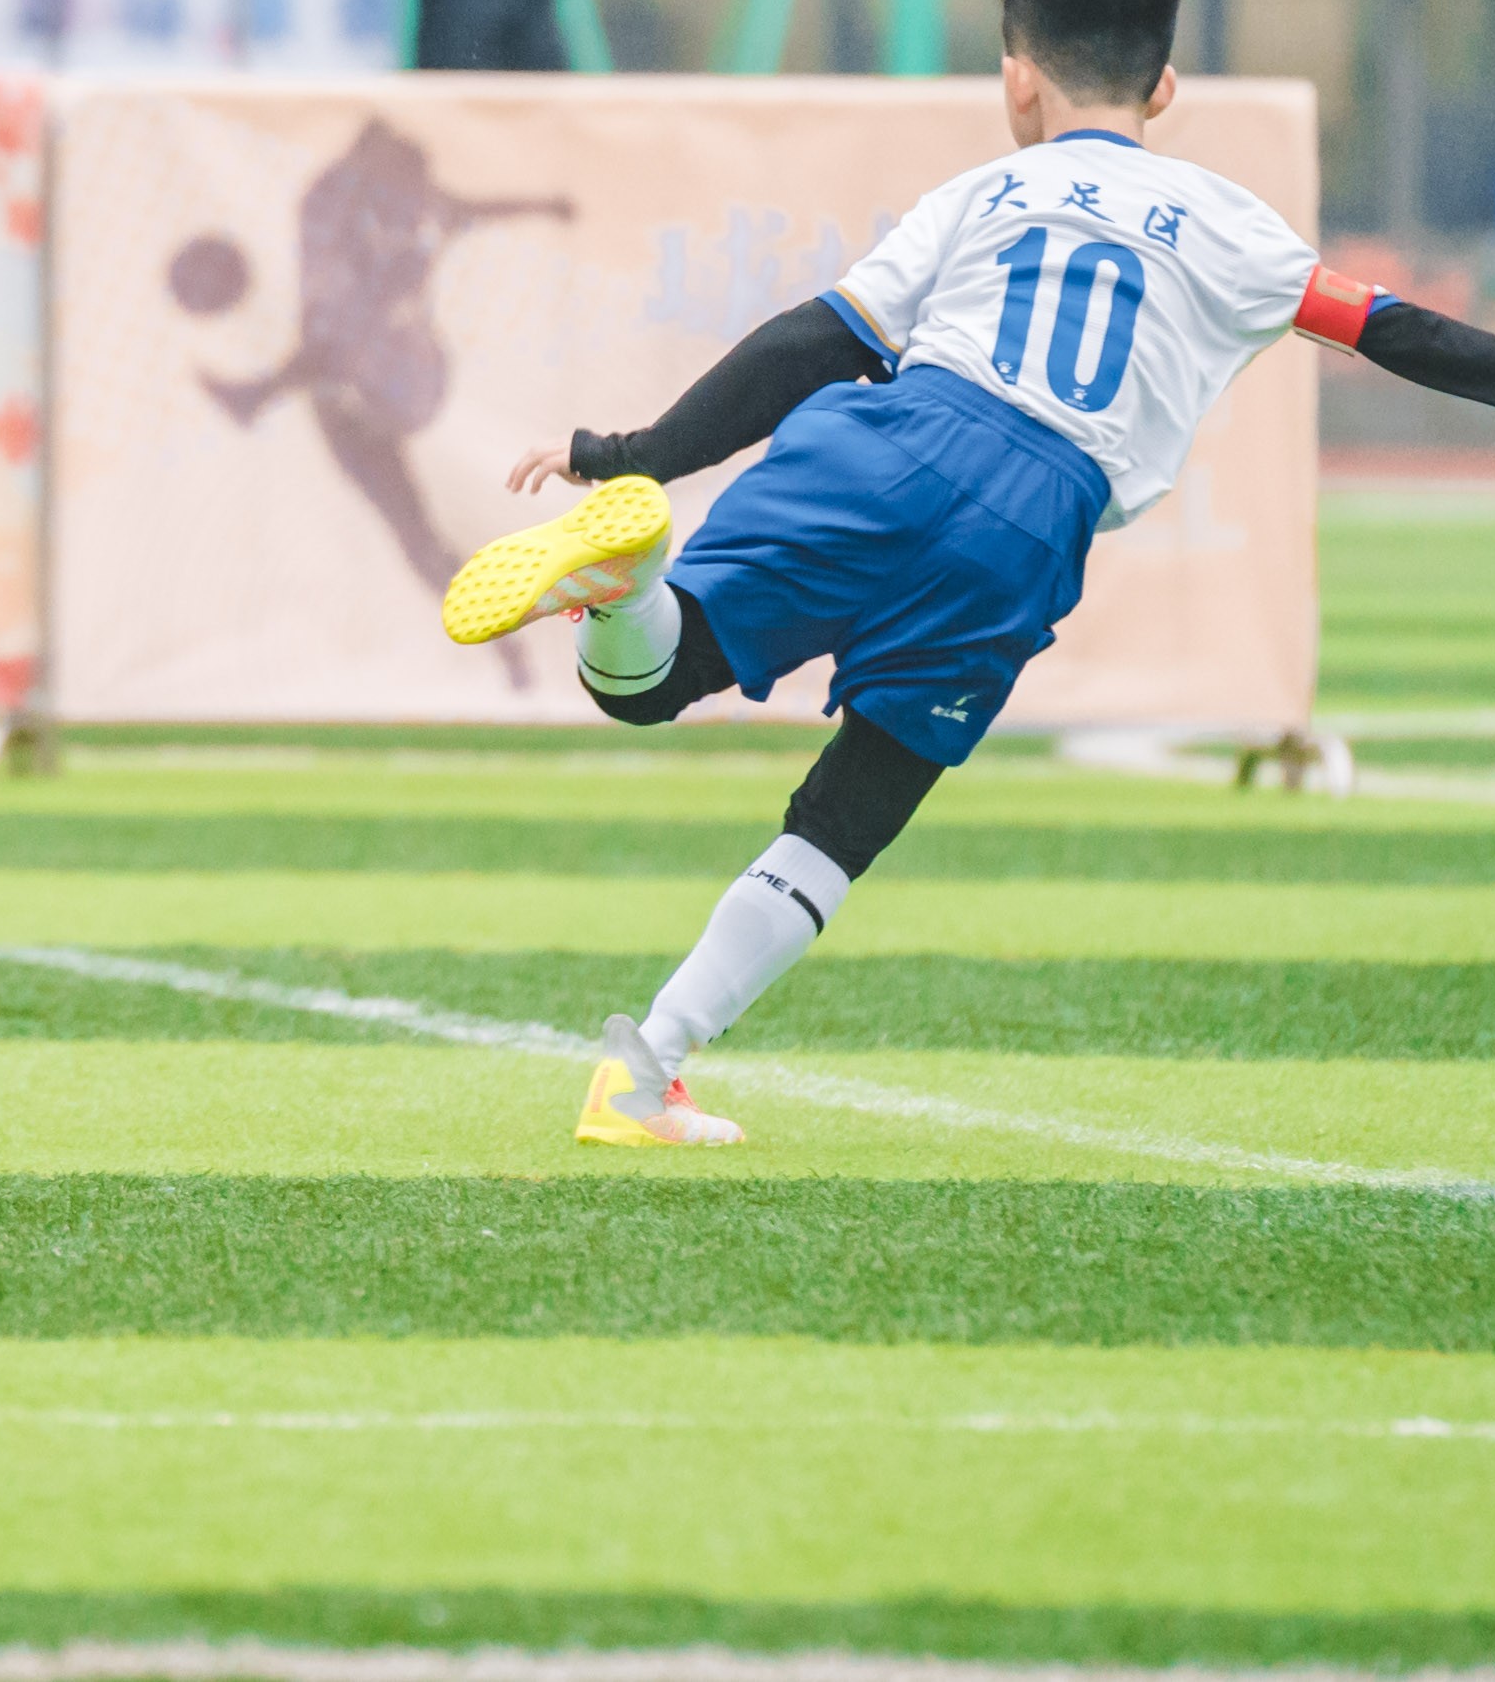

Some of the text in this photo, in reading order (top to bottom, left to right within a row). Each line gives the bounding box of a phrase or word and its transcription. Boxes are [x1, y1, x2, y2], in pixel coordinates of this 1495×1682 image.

[979, 174, 1188, 251] 大足区
[992, 226, 1145, 413] 10
